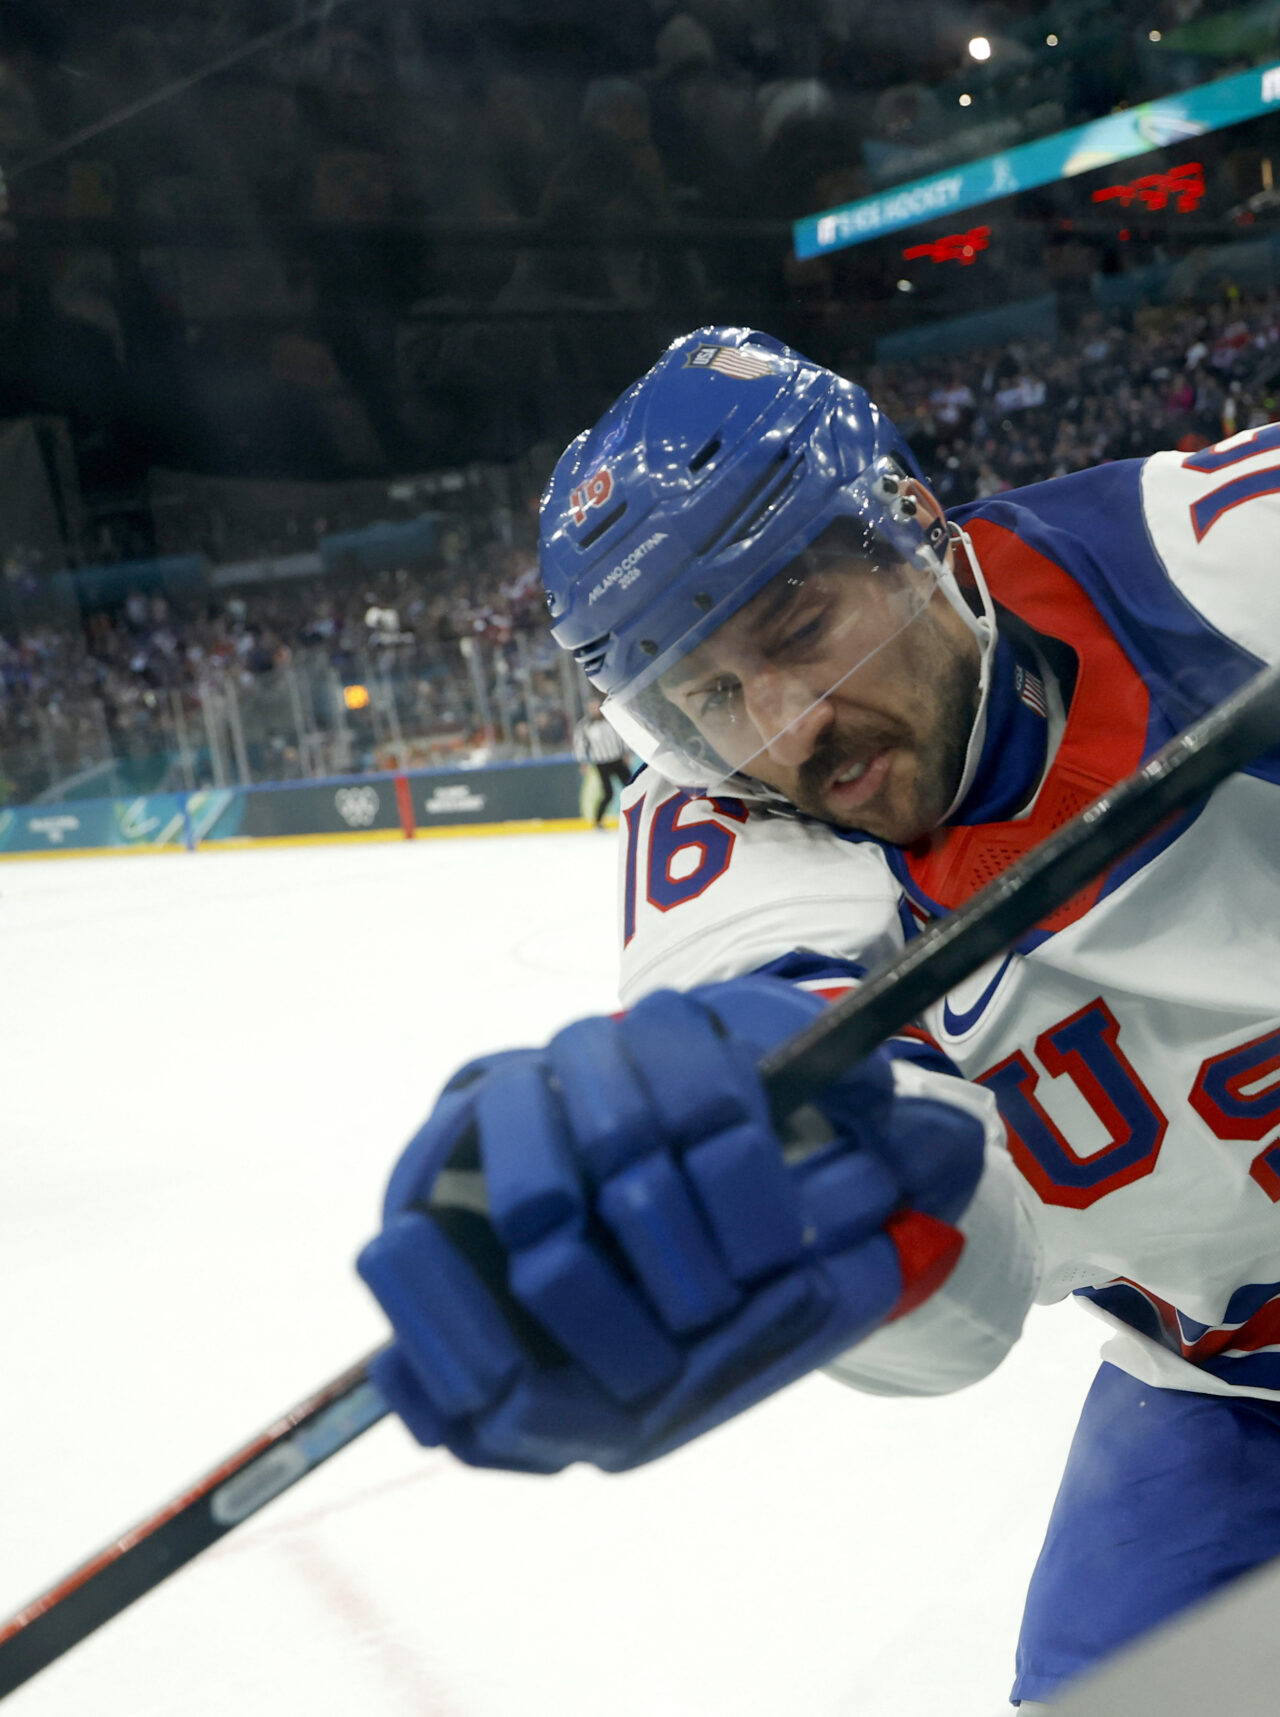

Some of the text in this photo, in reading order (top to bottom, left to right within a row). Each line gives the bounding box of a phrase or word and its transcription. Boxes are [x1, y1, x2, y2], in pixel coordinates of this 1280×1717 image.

[883, 174, 963, 221] HOCKEY
[692, 347, 718, 365] USA
[588, 532, 669, 606] MILANO CORTINA
[621, 785, 750, 952] 16
